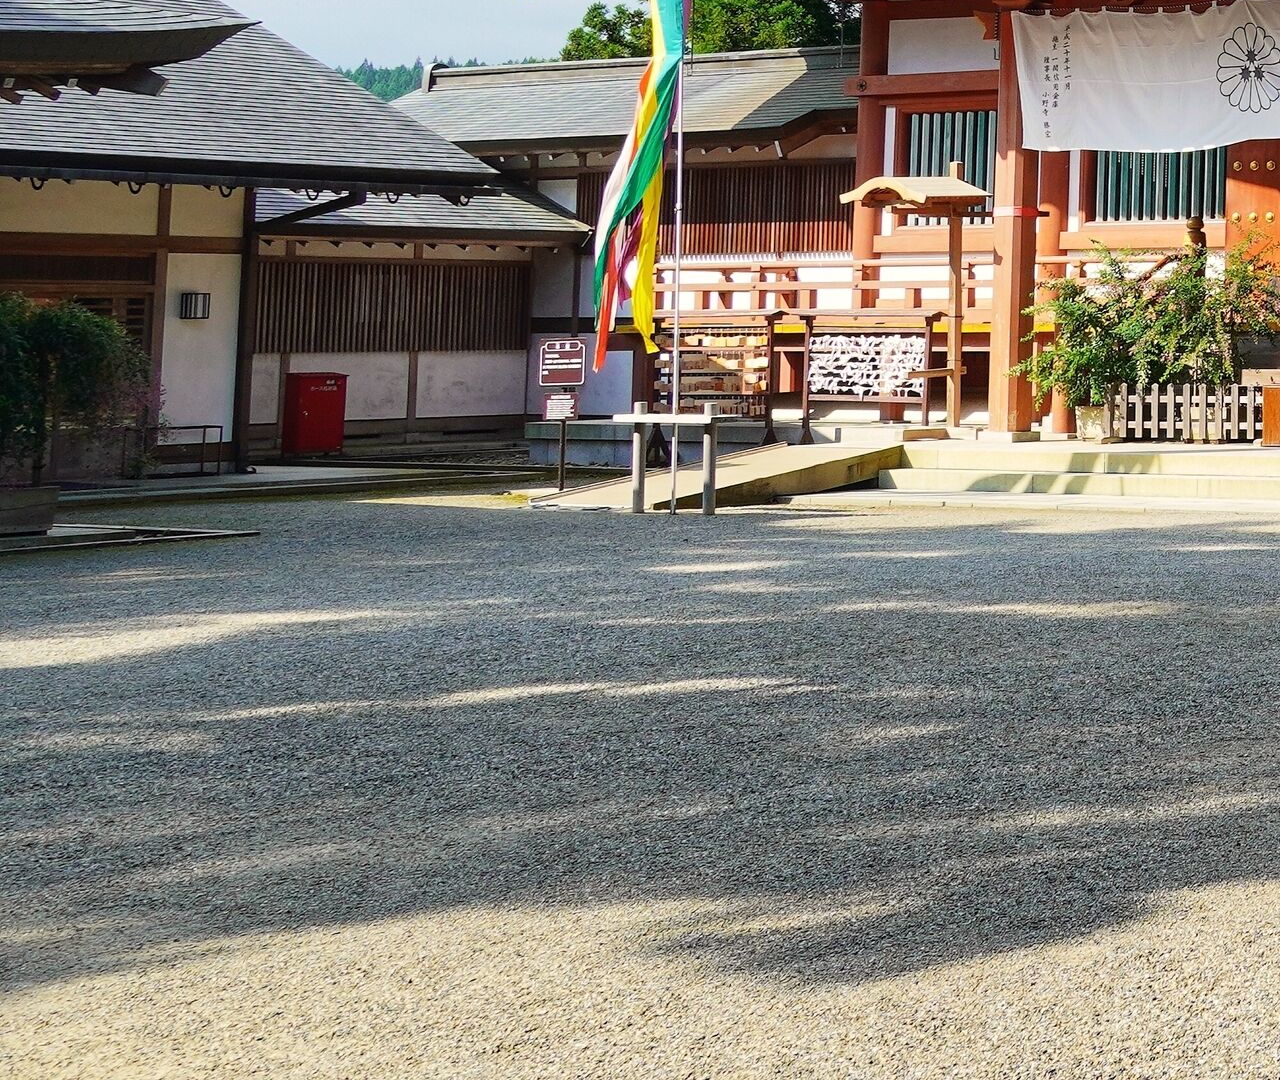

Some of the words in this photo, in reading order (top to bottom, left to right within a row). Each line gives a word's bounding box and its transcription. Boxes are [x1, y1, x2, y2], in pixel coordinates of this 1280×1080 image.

[1063, 24, 1071, 90] 平成二十年十一月
